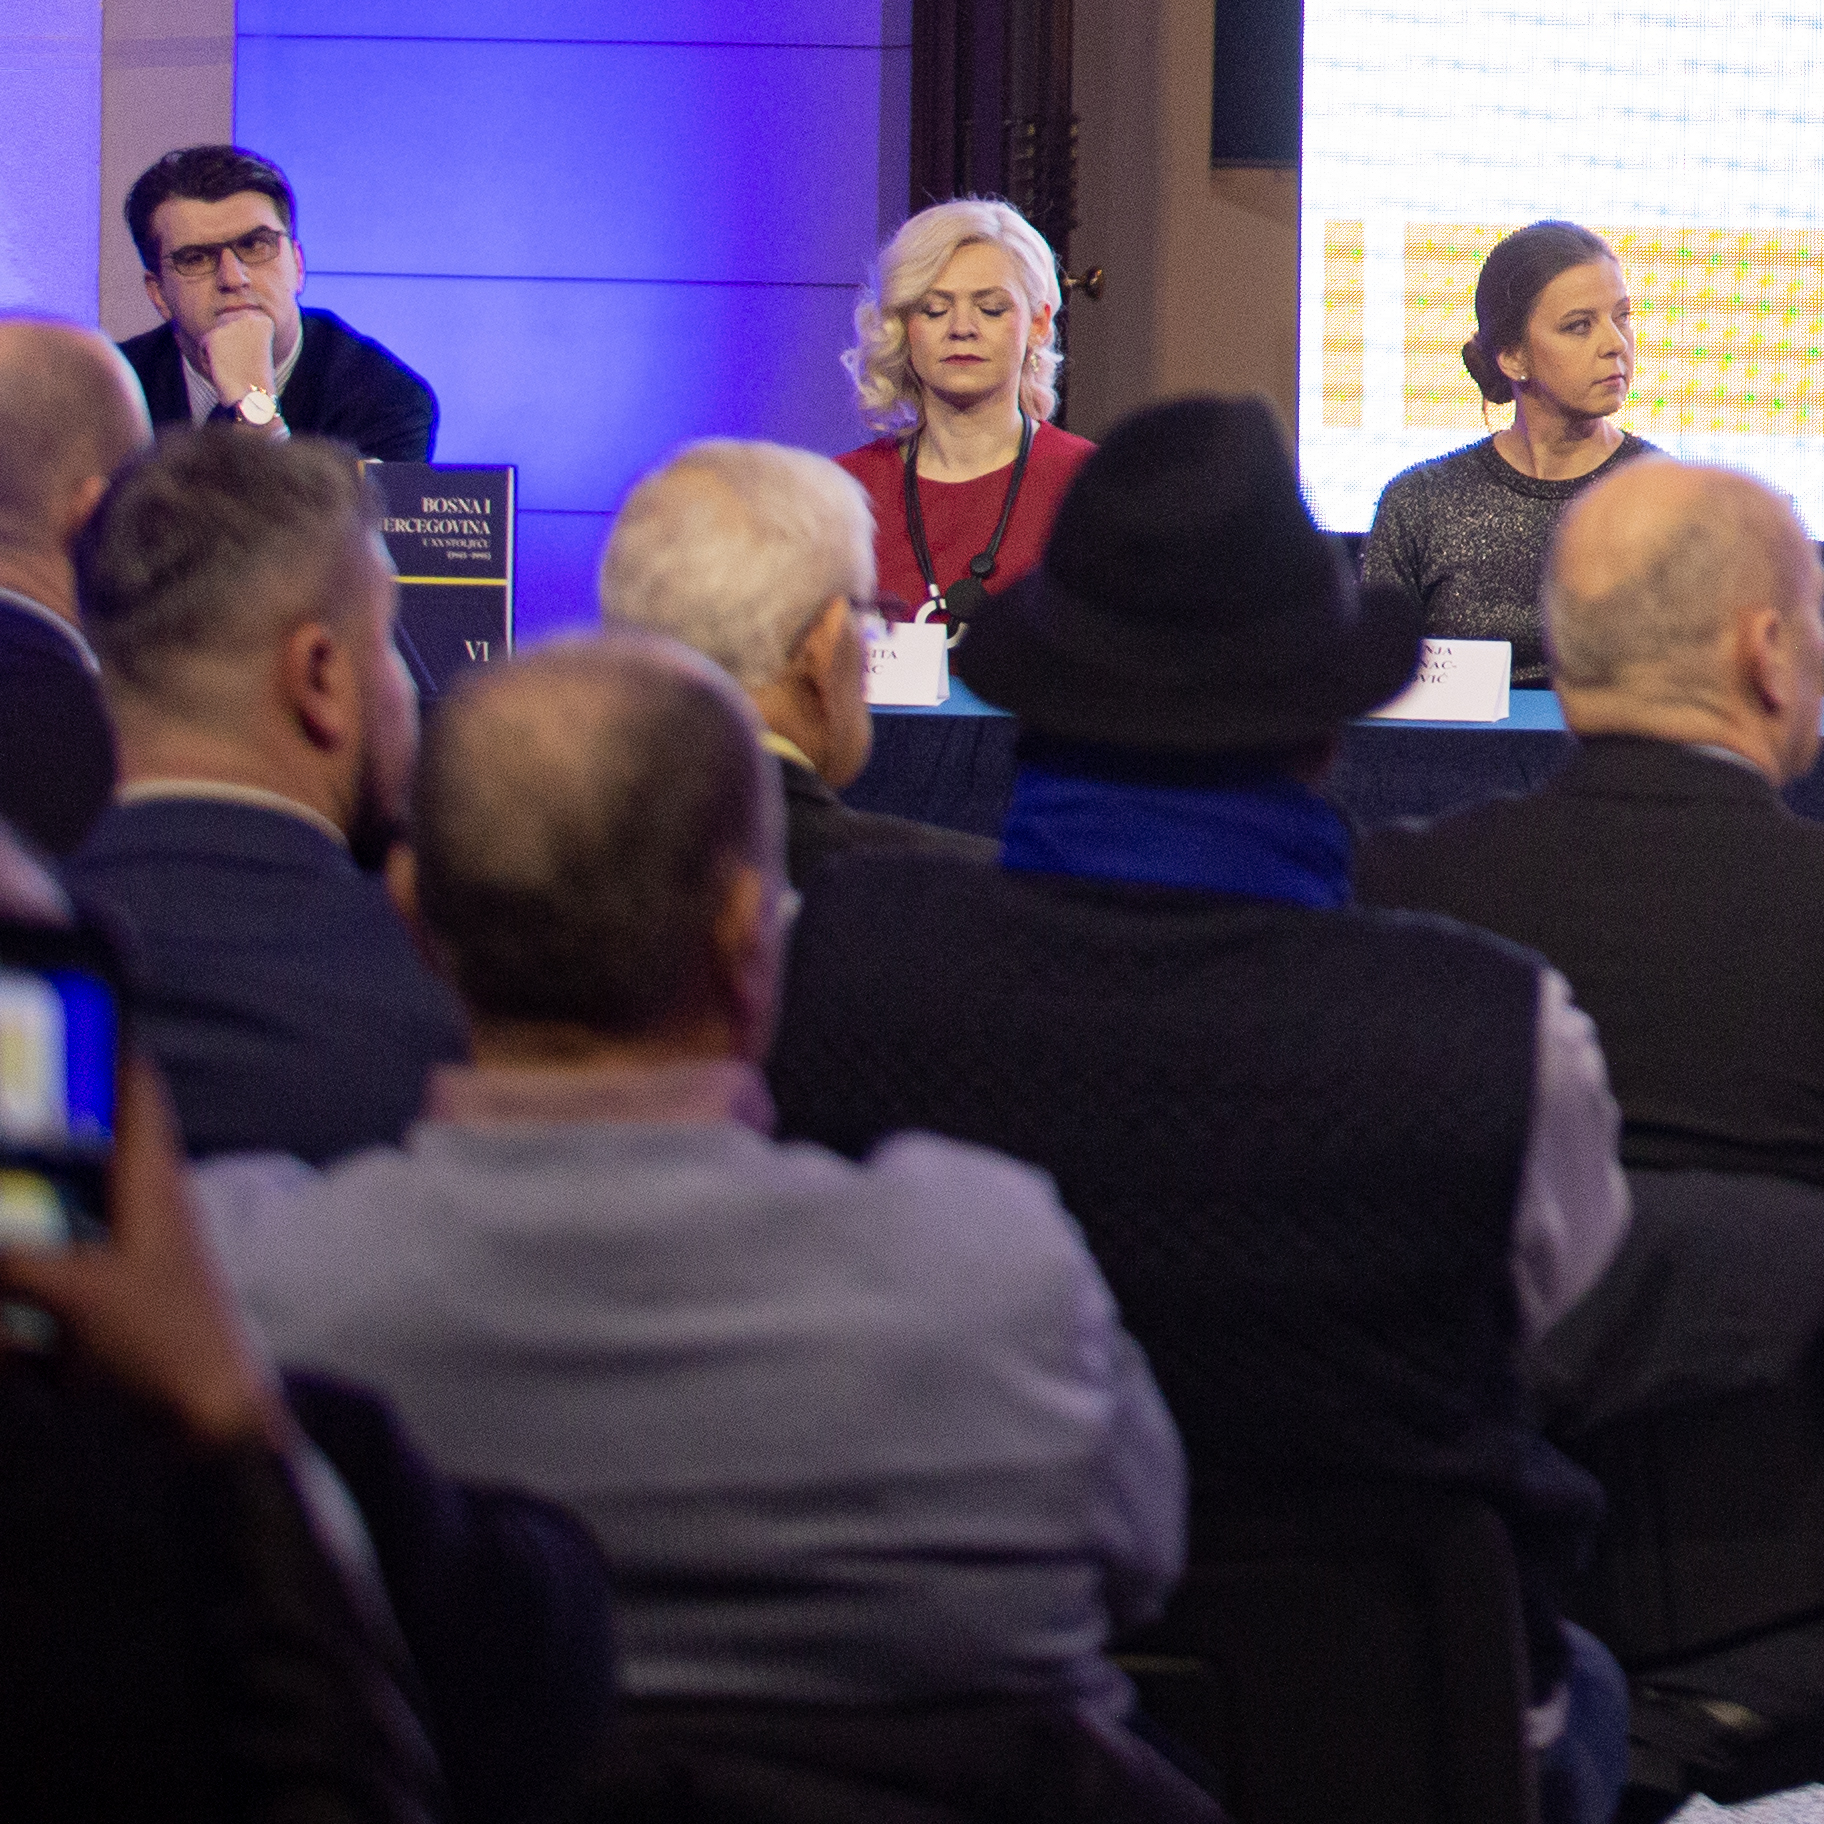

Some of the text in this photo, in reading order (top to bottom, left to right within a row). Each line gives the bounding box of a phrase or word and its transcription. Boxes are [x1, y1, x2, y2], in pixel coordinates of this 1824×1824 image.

[421, 496, 491, 515] BOSNA I
[380, 517, 491, 535] ERCEGOVINA
[464, 639, 490, 662] VI
